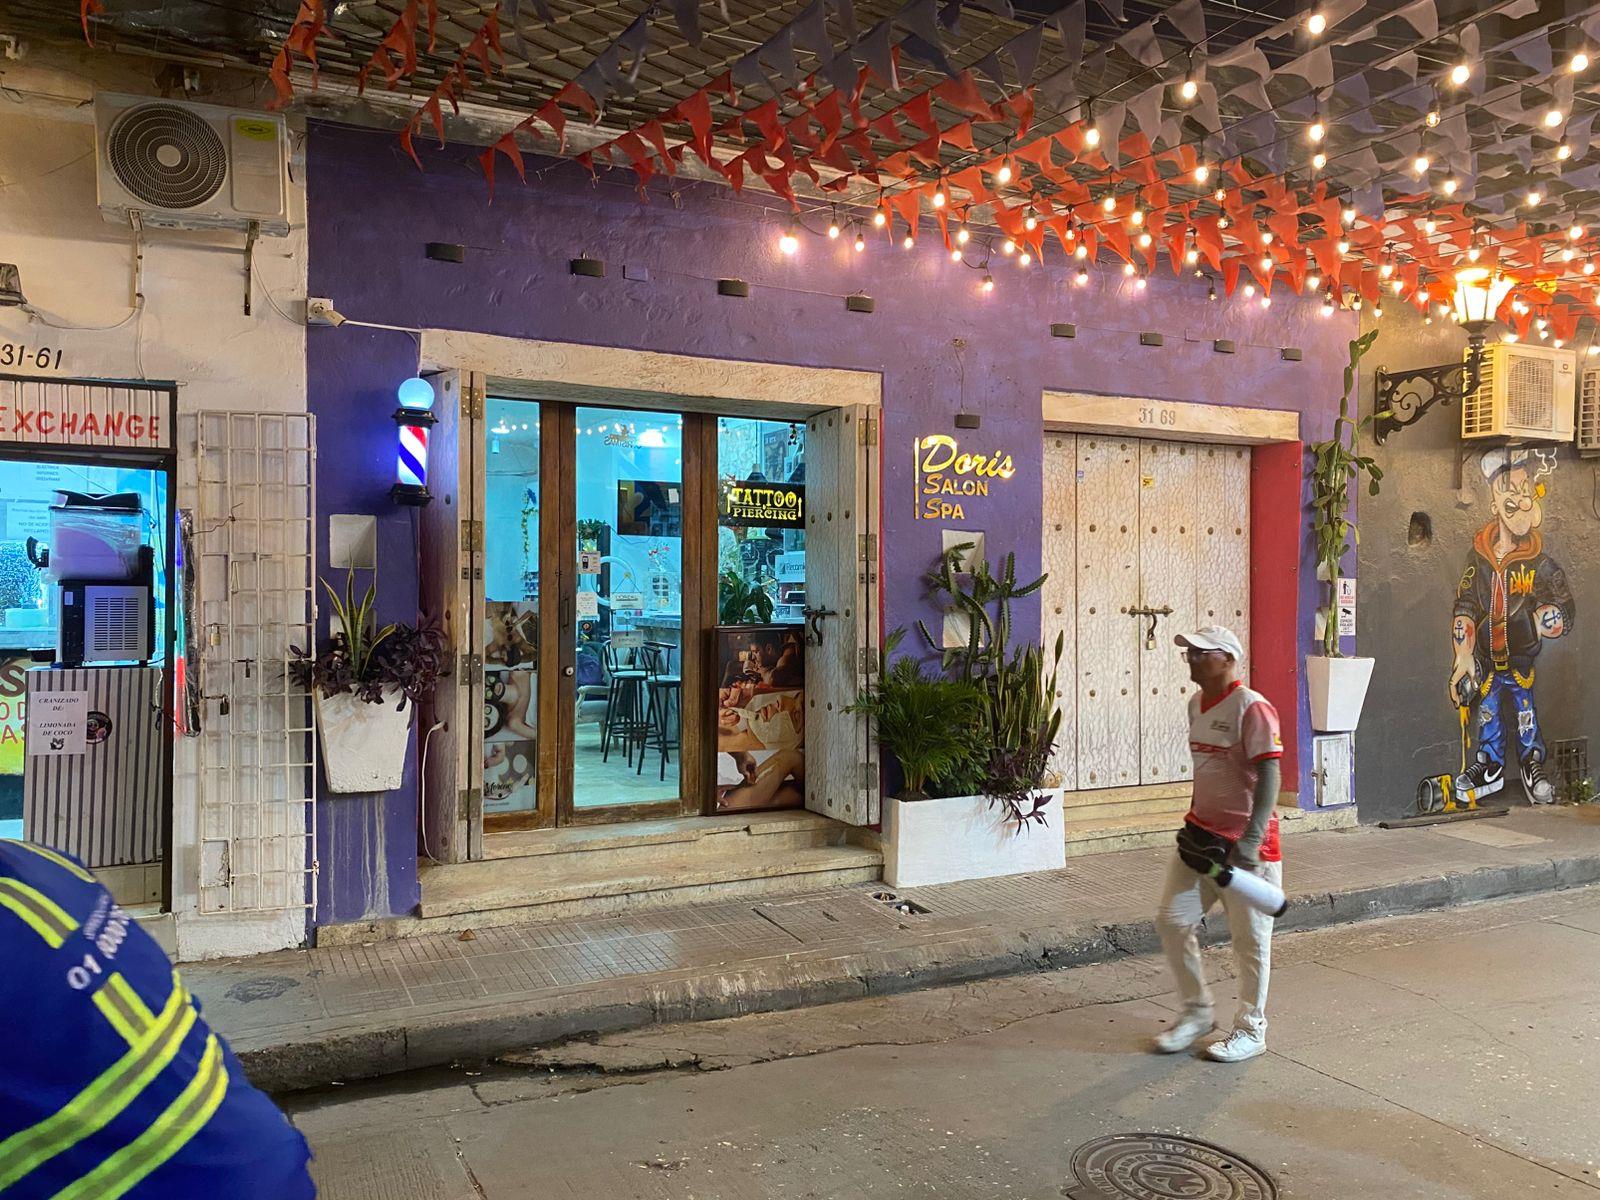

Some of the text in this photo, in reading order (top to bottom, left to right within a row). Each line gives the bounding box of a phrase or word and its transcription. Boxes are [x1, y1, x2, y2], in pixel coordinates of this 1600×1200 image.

[0, 343, 63, 370] 31-61
[1139, 407, 1154, 424] 31
[920, 434, 1016, 479] Doris
[923, 473, 989, 497] SALON
[731, 487, 797, 508] TATTOO
[732, 507, 797, 521] PIERCING
[923, 498, 965, 520] SPA
